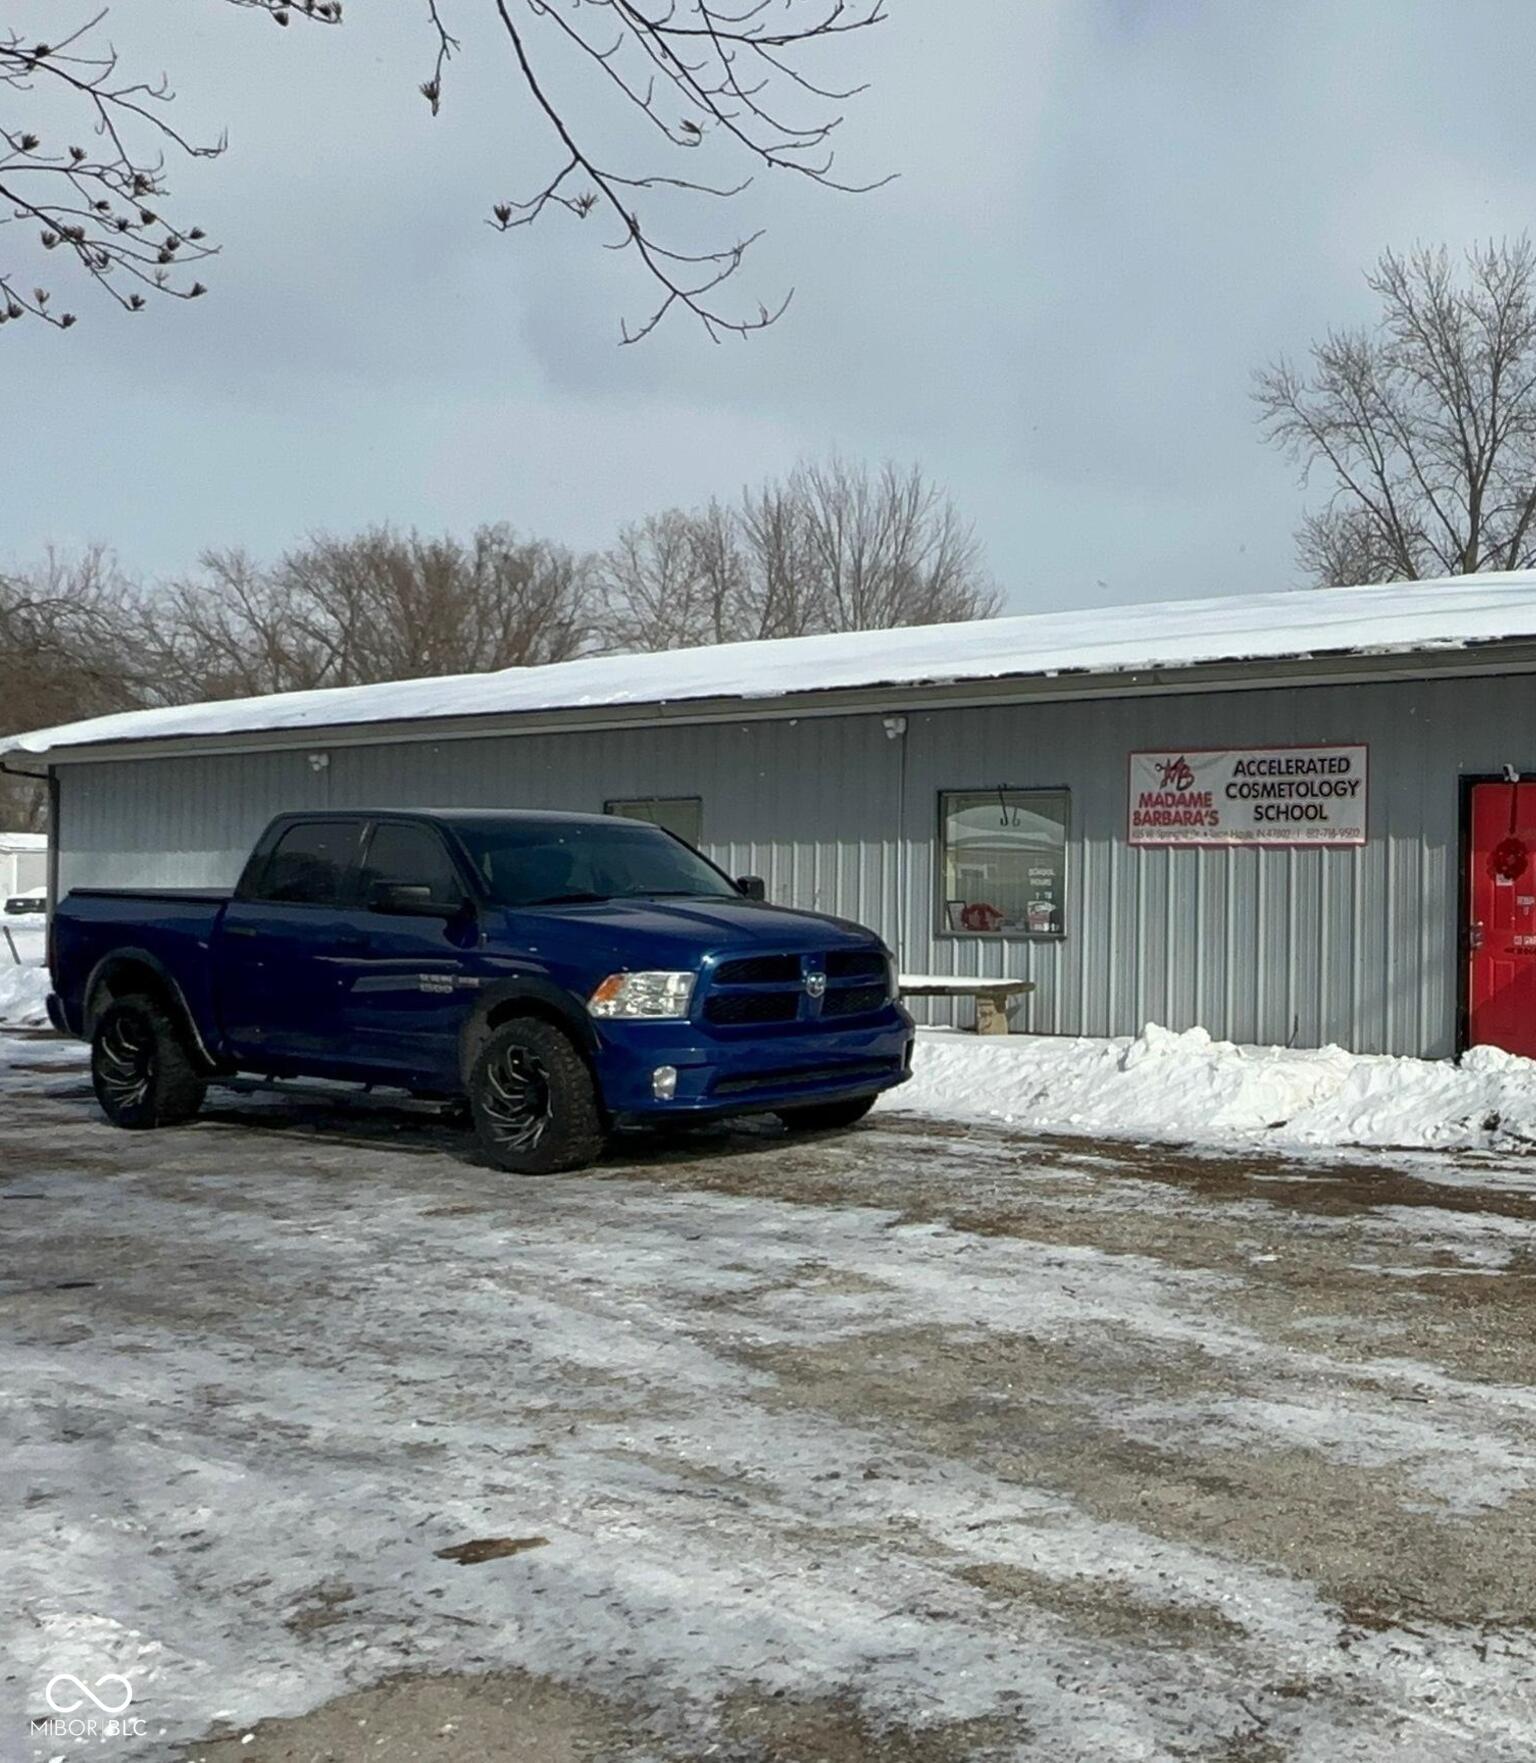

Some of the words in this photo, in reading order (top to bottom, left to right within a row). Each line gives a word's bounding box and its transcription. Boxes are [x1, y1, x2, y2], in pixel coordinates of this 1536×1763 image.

[1233, 757, 1351, 777] ACCELERATED
[1225, 780, 1361, 799] COSMETOLOGY
[1138, 791, 1214, 809] MADAME
[1133, 809, 1220, 827] BARBARA'S
[1253, 803, 1329, 822] SCHOOL
